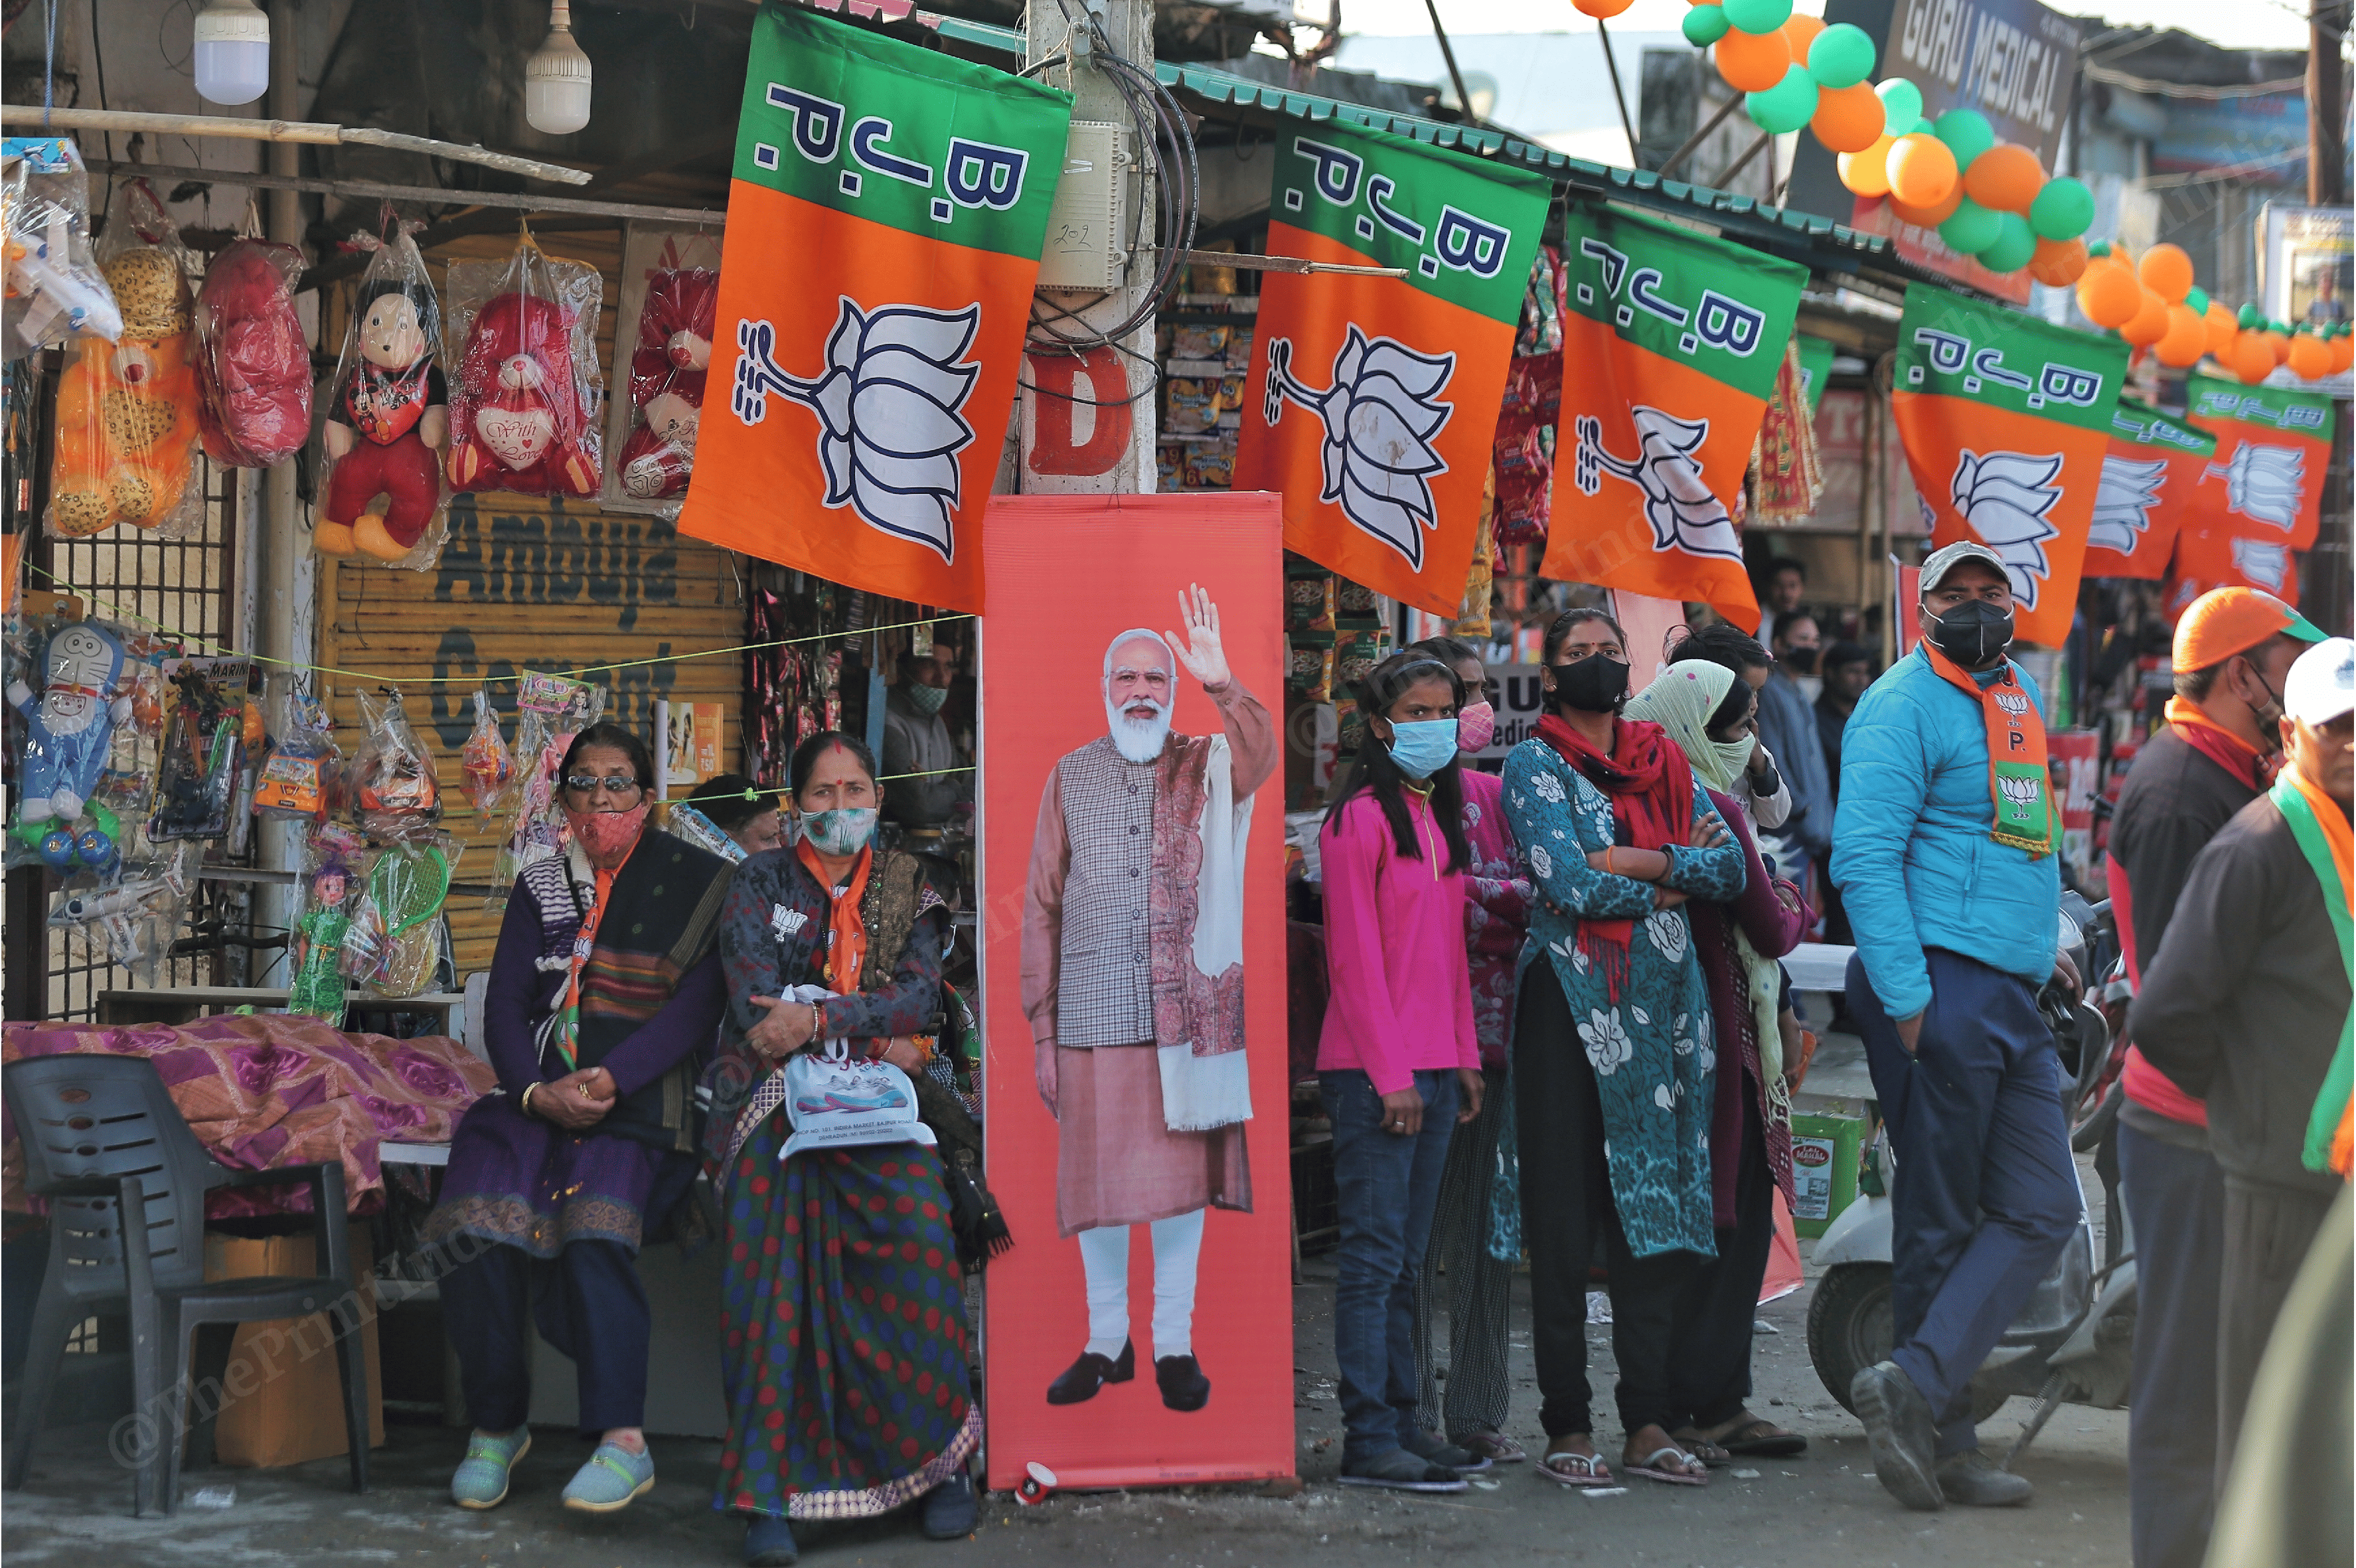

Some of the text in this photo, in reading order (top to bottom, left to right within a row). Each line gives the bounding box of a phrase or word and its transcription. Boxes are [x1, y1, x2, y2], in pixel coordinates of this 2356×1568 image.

[1967, 9, 2061, 134] MEDICAL
[486, 420, 536, 437] With
[499, 446, 542, 461] Love
[2007, 730, 2026, 751] P.
